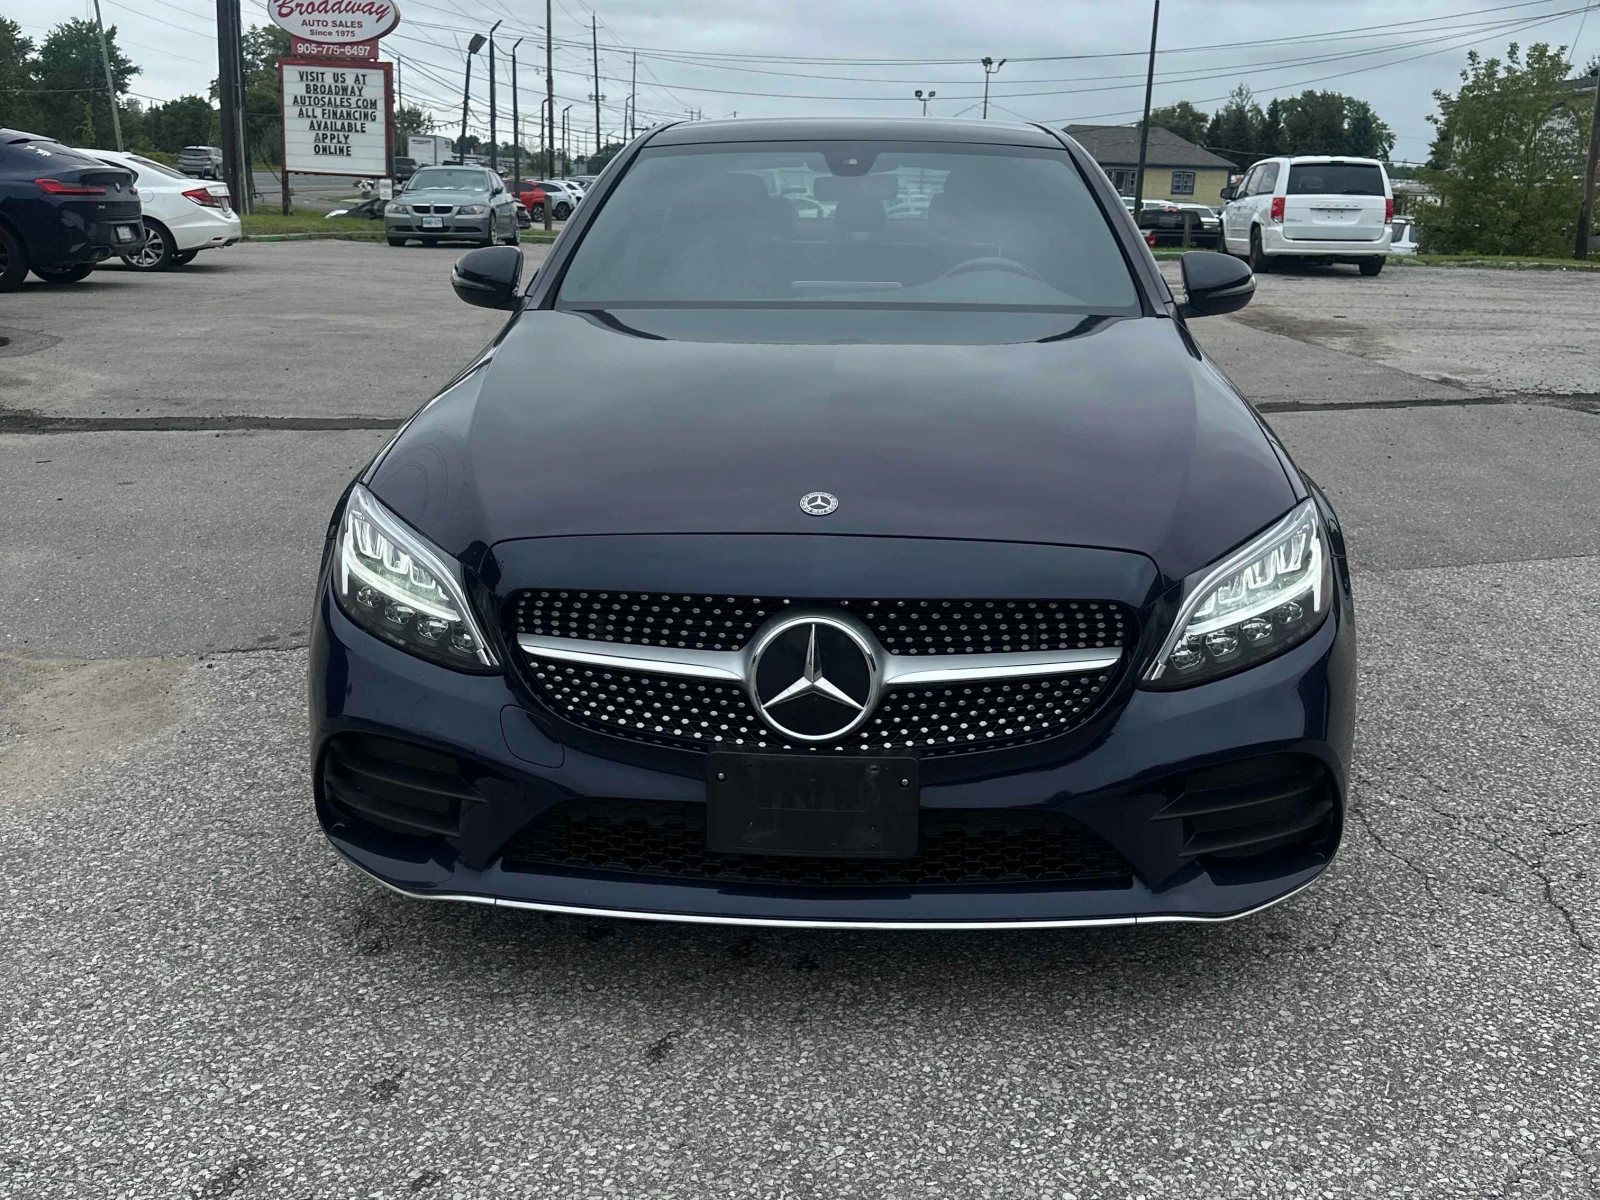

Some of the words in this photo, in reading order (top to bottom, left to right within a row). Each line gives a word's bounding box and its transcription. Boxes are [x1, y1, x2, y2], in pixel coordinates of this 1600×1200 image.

[274, 0, 390, 23] Broadway
[301, 19, 329, 27] AUTO
[331, 20, 363, 29] SALES
[309, 29, 333, 37] Since
[296, 43, 370, 56] 905-775-6497
[298, 71, 326, 83] VISIT
[333, 72, 346, 83] US
[354, 73, 367, 85] AT
[305, 83, 364, 97] BROADWAY
[298, 107, 318, 118] ALL
[322, 108, 377, 121] FINANCING
[309, 120, 366, 133] AVAILABLE
[314, 132, 350, 144] APPLY
[313, 144, 352, 156] ONLINE
